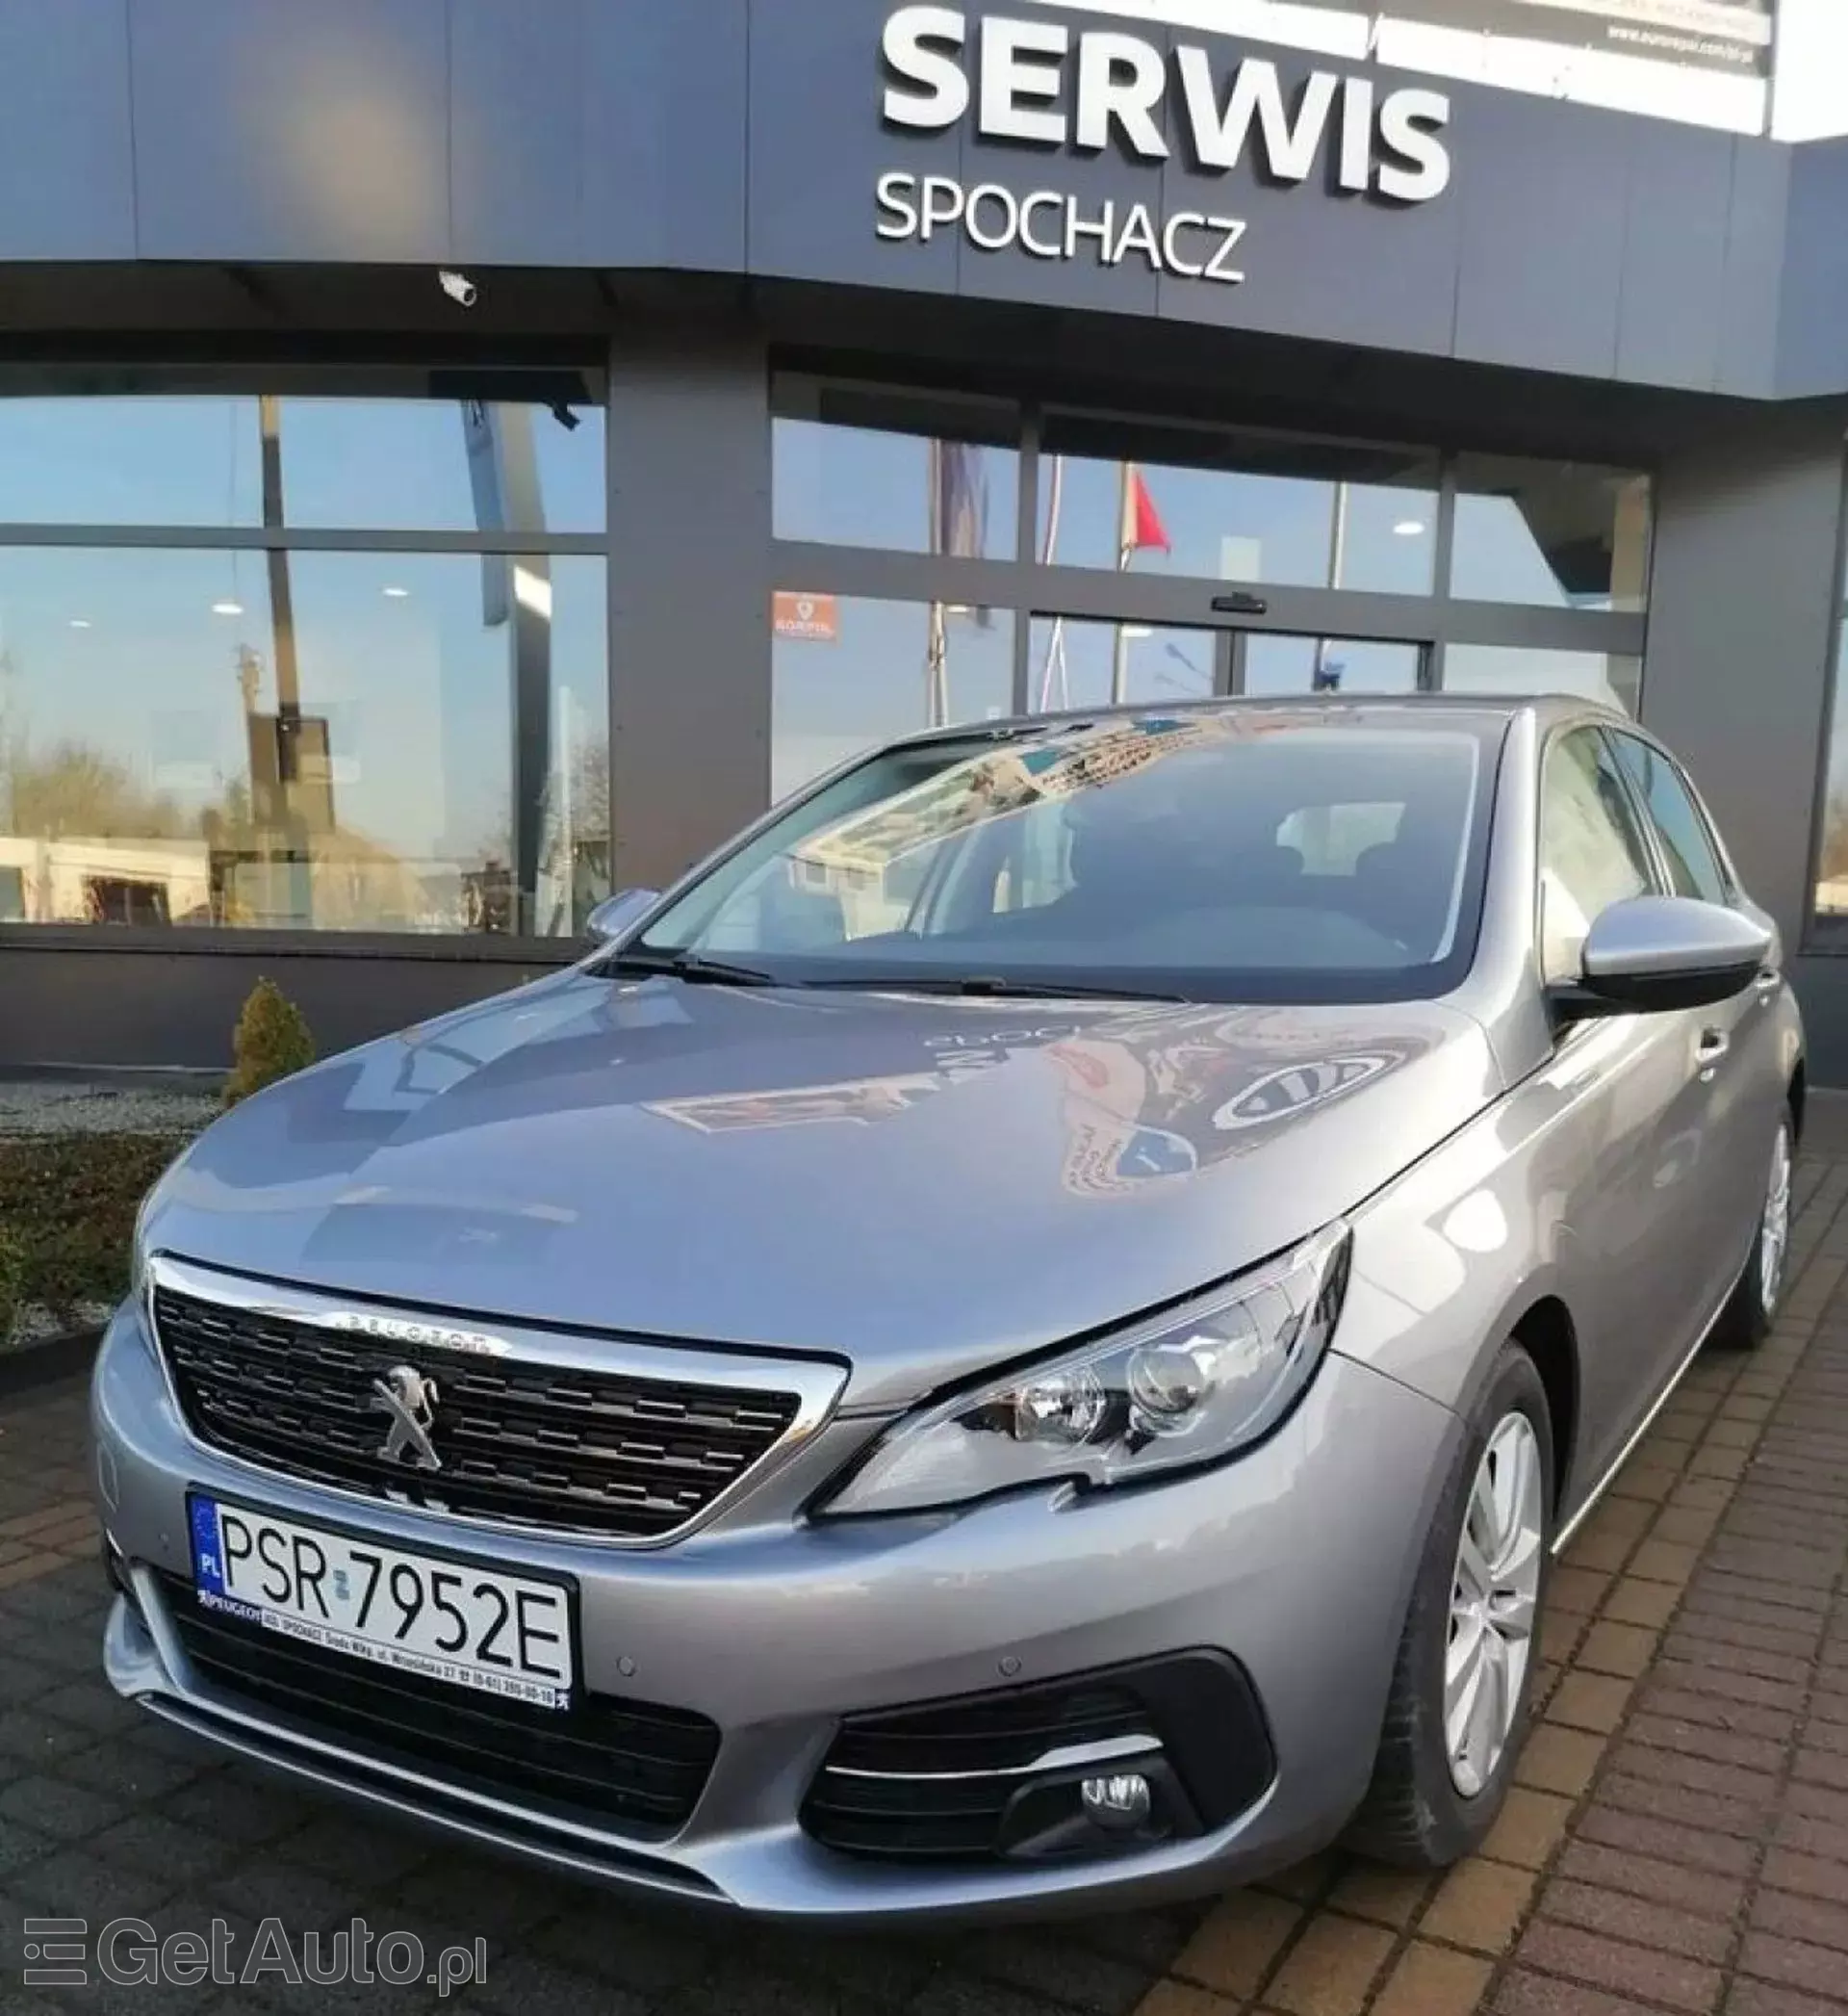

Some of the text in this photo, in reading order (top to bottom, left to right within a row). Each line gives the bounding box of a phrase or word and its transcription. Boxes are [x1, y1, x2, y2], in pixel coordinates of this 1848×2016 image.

[883, 6, 1450, 202] SERWIS
[877, 172, 1246, 282] SPOCHACZ
[201, 1553, 221, 1579] PL
[221, 1514, 561, 1678] PSR 7952E
